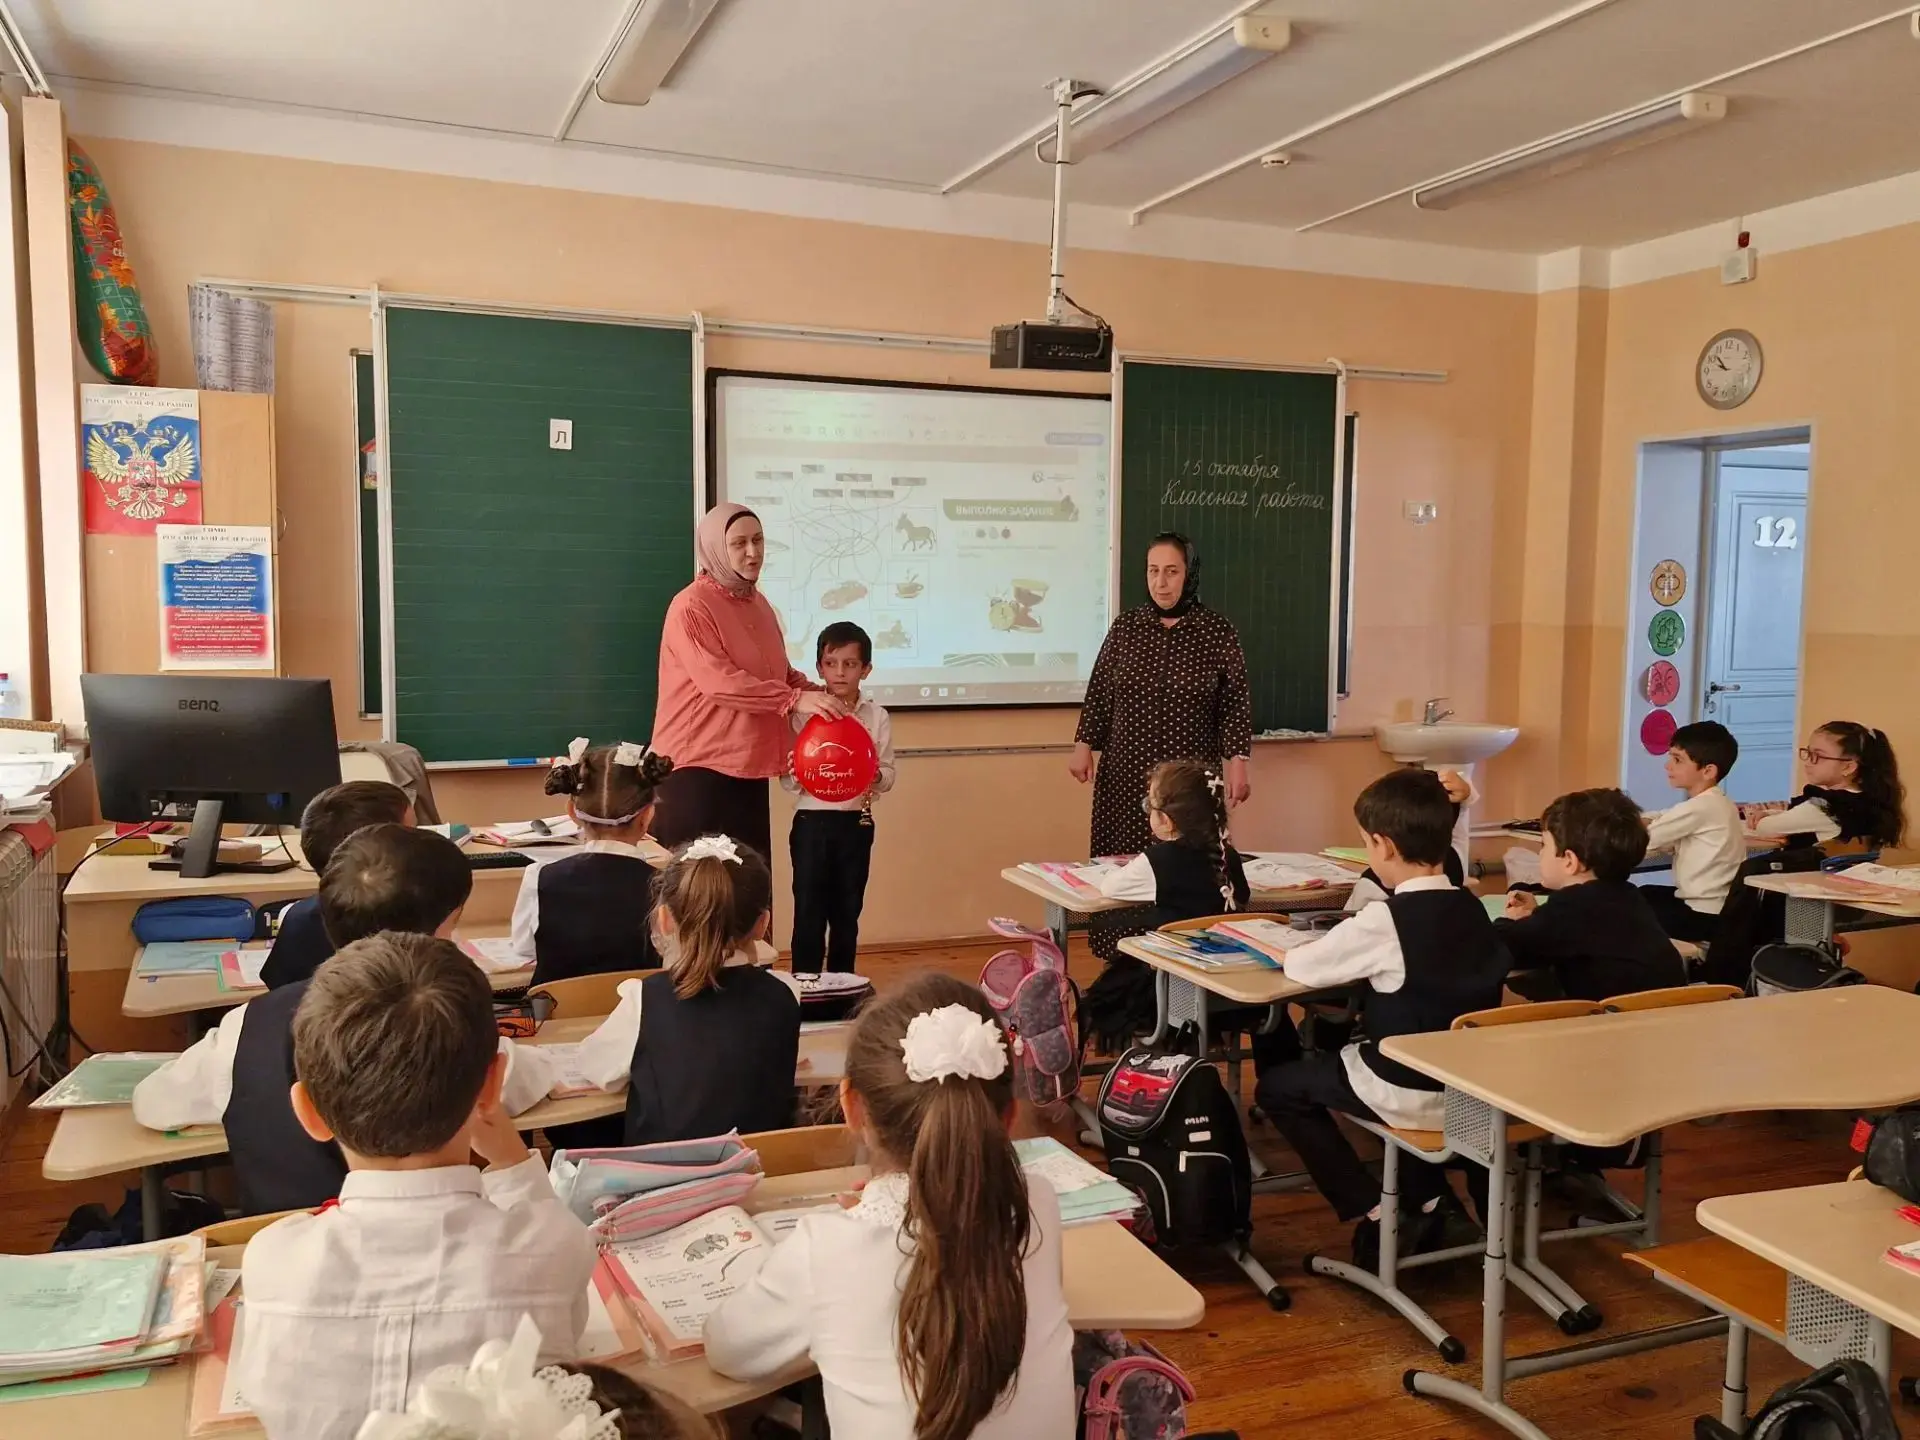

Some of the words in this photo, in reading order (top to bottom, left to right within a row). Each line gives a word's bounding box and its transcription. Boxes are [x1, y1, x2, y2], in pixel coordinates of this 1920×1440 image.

[1725, 340, 1734, 349] 12
[555, 430, 567, 444] Л
[1182, 459, 1202, 476] 15
[1207, 454, 1280, 487] октября
[1161, 479, 1248, 507] Классная
[1254, 481, 1325, 518] работа
[955, 505, 1006, 516] ВЫПОЛНИ
[1753, 516, 1797, 549] 12
[178, 699, 221, 712] BenQ
